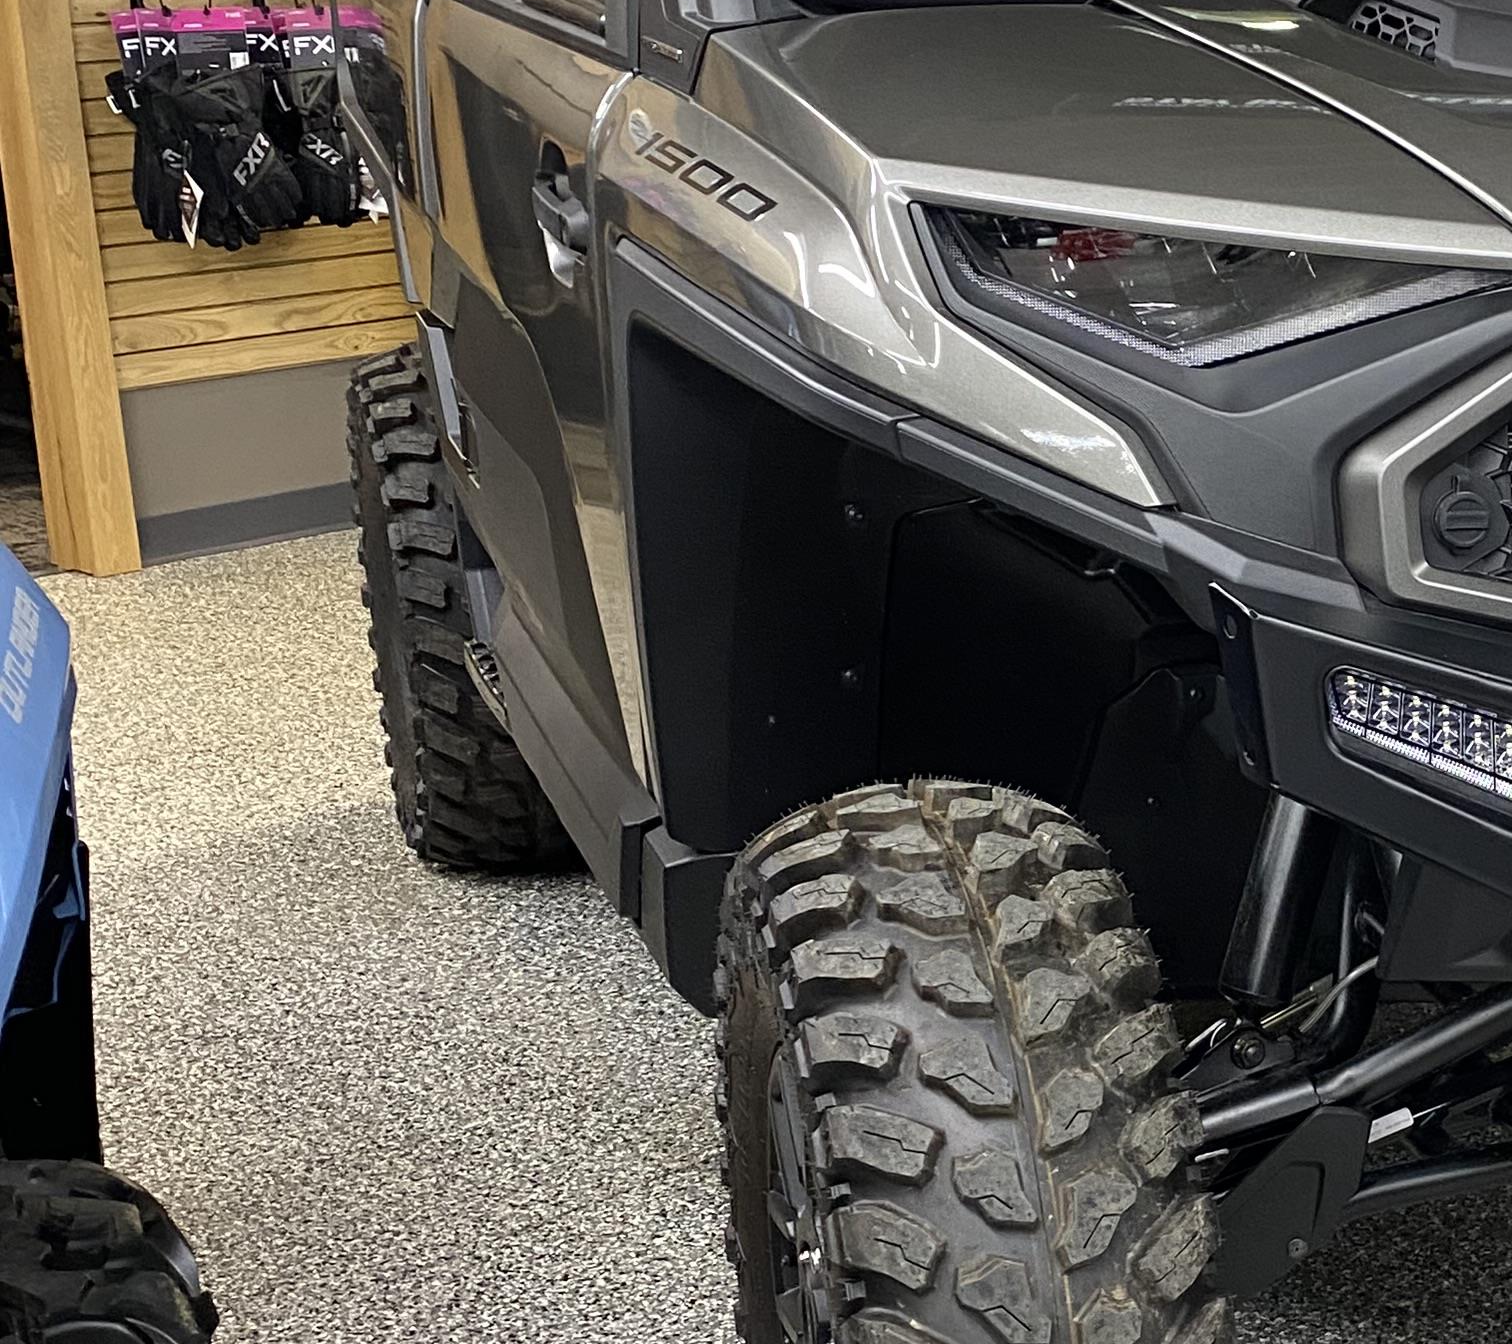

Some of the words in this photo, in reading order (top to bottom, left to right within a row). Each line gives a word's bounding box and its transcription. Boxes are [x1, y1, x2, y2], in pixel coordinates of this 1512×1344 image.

[232, 131, 270, 187] FXR
[302, 132, 344, 166] FXR
[635, 131, 779, 223] 1500
